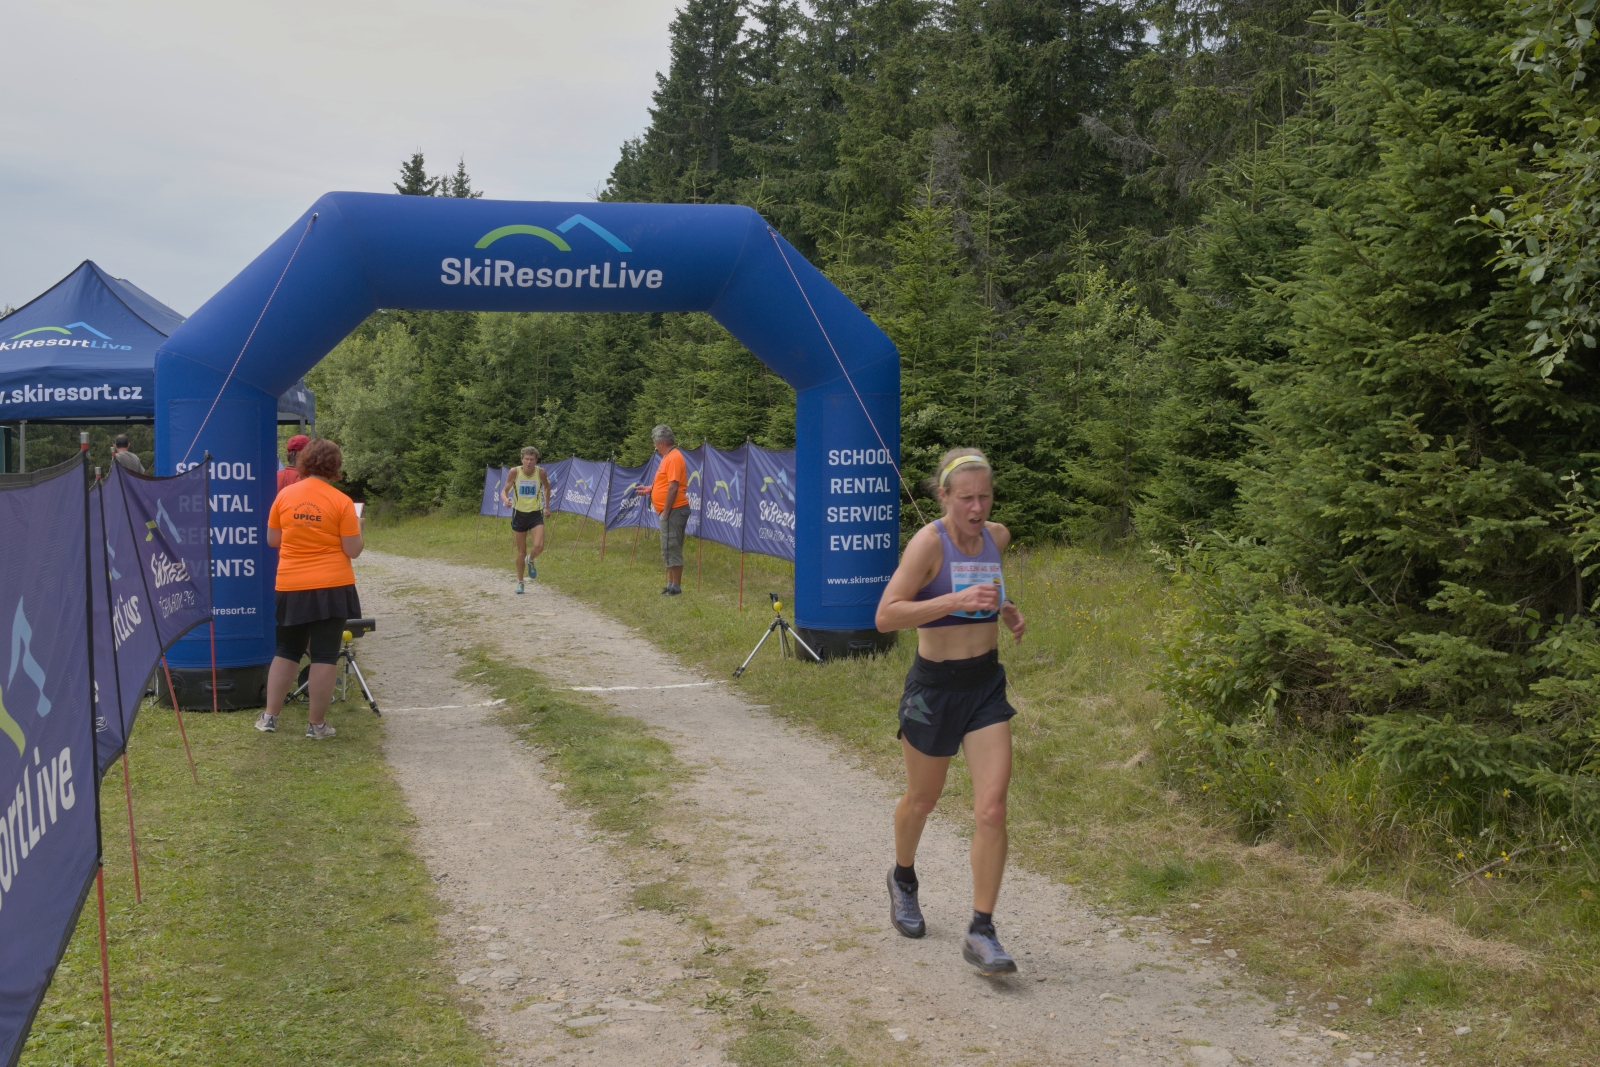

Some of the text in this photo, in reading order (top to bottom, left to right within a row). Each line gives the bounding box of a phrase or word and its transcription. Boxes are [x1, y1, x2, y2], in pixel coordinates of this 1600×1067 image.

[441, 257, 663, 289] SkiResortLive
[828, 449, 893, 466] SCHOOL
[522, 486, 535, 495] 104
[830, 477, 891, 494] RENTAL
[827, 505, 893, 523] SERVICE
[830, 533, 891, 551] EVENTS
[827, 575, 891, 585] www.skiresort.cz
